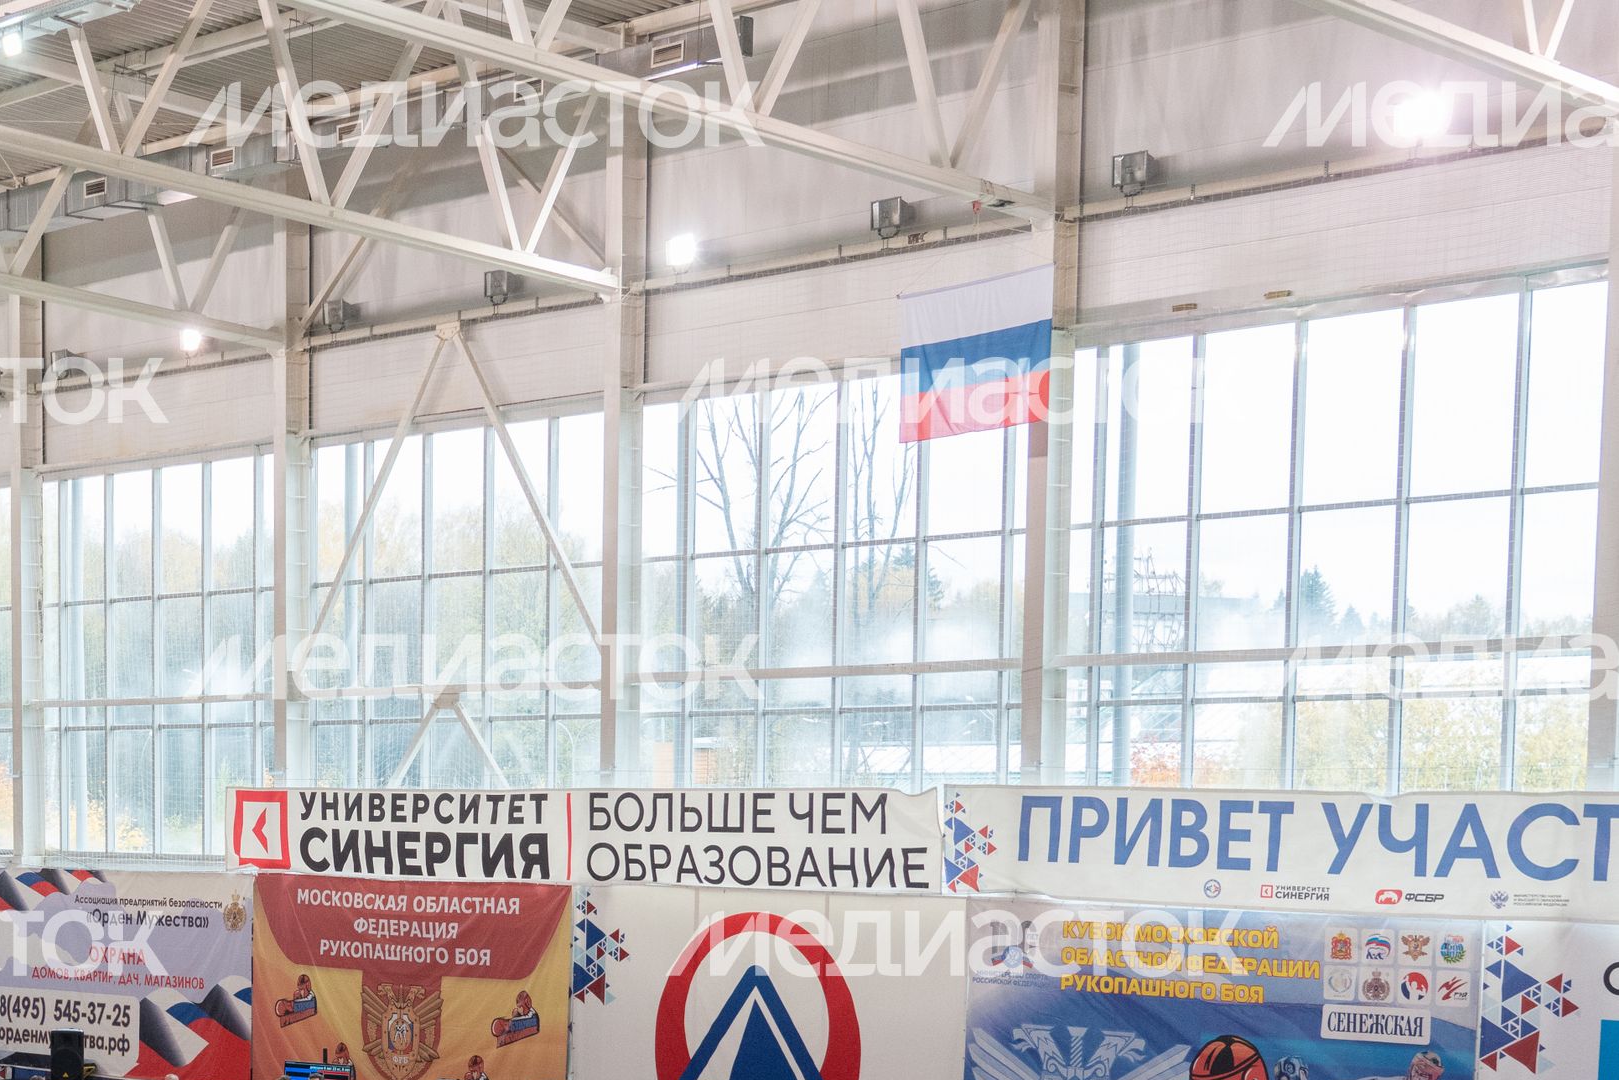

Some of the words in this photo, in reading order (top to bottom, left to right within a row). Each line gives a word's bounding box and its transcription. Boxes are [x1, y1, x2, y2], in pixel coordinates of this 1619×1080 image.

[299, 791, 548, 825] УНИВЕРСИТЕТ
[589, 792, 776, 834] БОЛЬШЕ
[788, 792, 888, 835] ЧЕМ
[1017, 795, 1295, 873] ПРИВЕТ
[1320, 802, 1619, 882] УЧАСТ
[299, 827, 550, 880] СИНЕРГИЯ
[586, 842, 930, 889] ОБРАЗОВАНИЕ
[74, 894, 118, 905] Ассоциация
[119, 896, 167, 908] предприятий
[169, 897, 223, 909] безопасности
[297, 888, 408, 912] МОСКОВСКАЯ
[412, 895, 520, 915] ОБЛАСТНАЯ
[1275, 885, 1331, 893] УНИВЕРСИТЕТ
[1275, 891, 1330, 901] СИНЕРГИЯ
[1404, 892, 1445, 903] ФСБР
[136, 913, 209, 929] Мужества»
[353, 918, 459, 940] ФЕДЕРАЦИЯ
[1062, 920, 1129, 942] КУБОК
[1134, 924, 1280, 949] МОСКОВСКОЙ
[89, 945, 146, 966] ОХРАНА
[320, 940, 449, 965] РУКОПАШНОГО
[454, 948, 491, 967] БОЯ
[1061, 946, 1182, 972] ОБЛАСТНОЙ
[1186, 955, 1321, 980] ФЕДЕРАЦИИ
[144, 975, 205, 990] МАГАЗИНОВ
[1060, 974, 1217, 1001] РУКОПАШНОГО
[1220, 983, 1265, 1004] БОЯ
[0, 995, 47, 1025] 8(495)
[53, 999, 131, 1027] 545-37-25
[1326, 1010, 1424, 1038] СЕНЕЖСКАЯ
